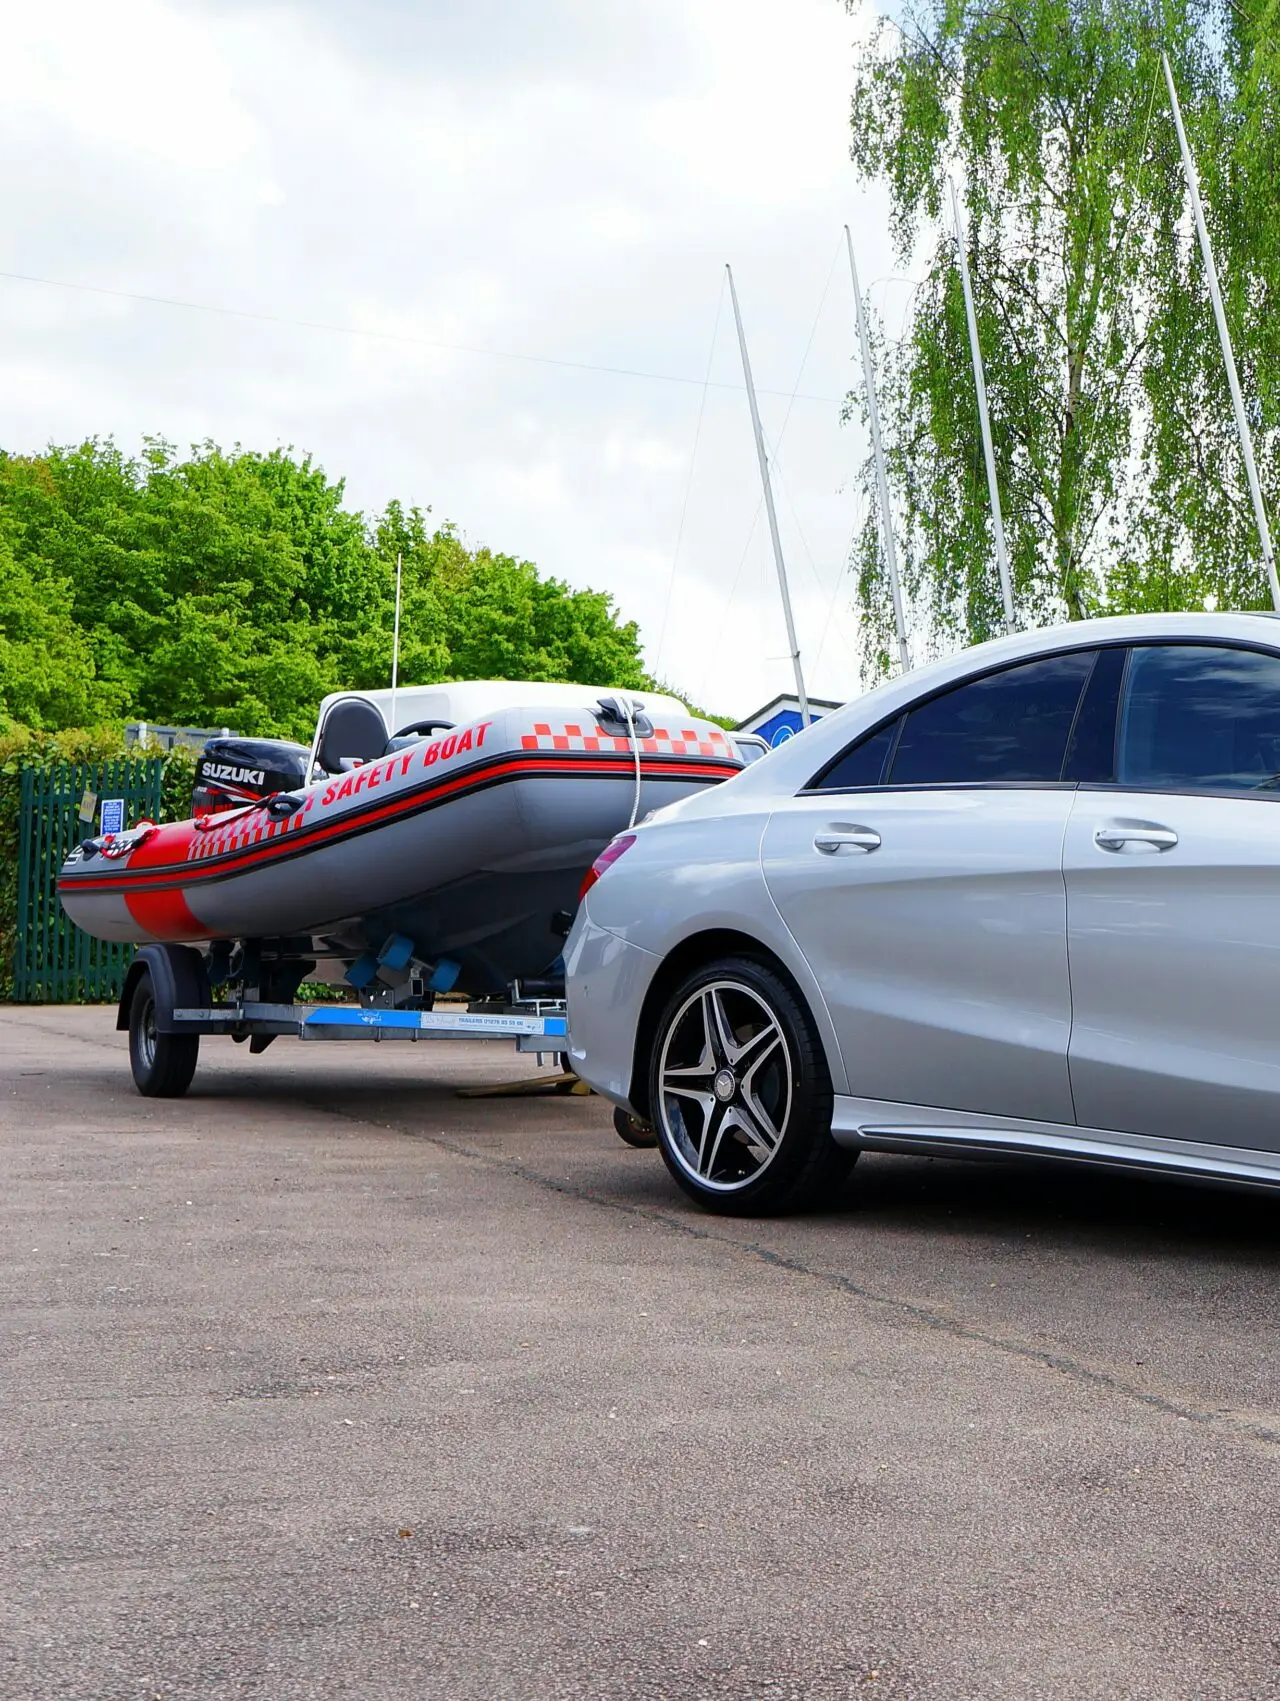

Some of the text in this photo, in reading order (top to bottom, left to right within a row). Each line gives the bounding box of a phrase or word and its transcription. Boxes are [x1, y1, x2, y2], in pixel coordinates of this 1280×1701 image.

[201, 762, 265, 785] SUZUKI
[321, 721, 493, 806] SAFETY BOAT
